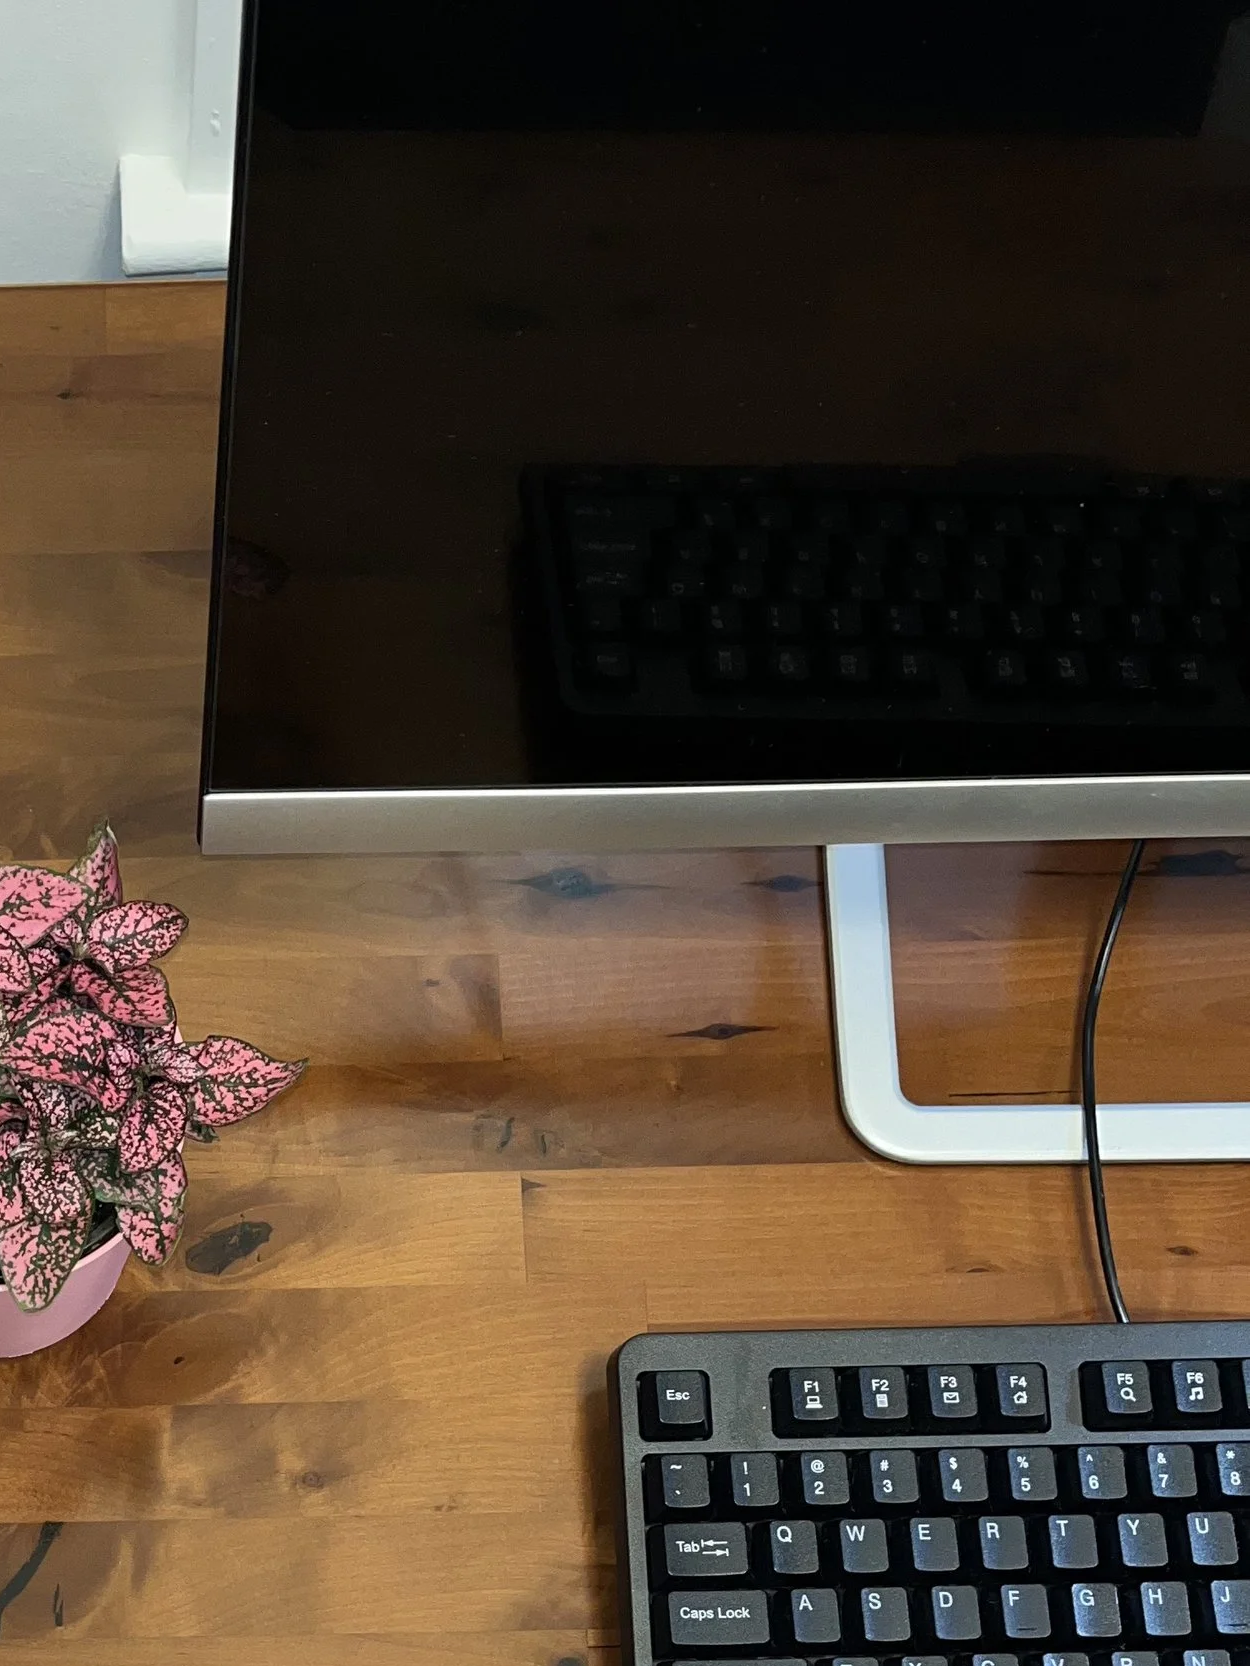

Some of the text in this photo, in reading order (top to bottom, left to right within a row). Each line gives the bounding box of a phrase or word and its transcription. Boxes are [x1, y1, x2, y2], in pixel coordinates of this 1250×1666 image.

[871, 1378, 890, 1392] F2
[939, 1375, 958, 1388] F3
[1009, 1375, 1028, 1388] F4
[1116, 1372, 1134, 1386] F5
[1186, 1371, 1205, 1384] F6
[803, 1380, 820, 1393] F1
[666, 1389, 691, 1401] Esc
[879, 1459, 889, 1472] #
[948, 1456, 958, 1470] $
[1016, 1455, 1029, 1469] %
[1156, 1452, 1167, 1465] &
[743, 1461, 749, 1475] !
[810, 1459, 825, 1474] @
[882, 1479, 893, 1493] 3
[951, 1478, 963, 1493] 4
[1020, 1477, 1031, 1492] 5
[1088, 1474, 1100, 1490] 6
[1158, 1473, 1169, 1488] 7
[1230, 1471, 1241, 1486] 8
[743, 1482, 751, 1497] 1
[813, 1480, 825, 1495] 2
[845, 1525, 866, 1542] W
[917, 1523, 932, 1541] E
[985, 1522, 1000, 1539] R
[1055, 1519, 1069, 1537] T
[1126, 1519, 1140, 1536] Y
[1194, 1517, 1209, 1535] U
[776, 1525, 793, 1543] Q
[675, 1540, 700, 1553] Tab
[868, 1592, 882, 1610] S
[938, 1591, 953, 1608] D
[1008, 1590, 1020, 1607] F
[1079, 1588, 1095, 1607] G
[1148, 1588, 1163, 1605] H
[1220, 1586, 1231, 1603] J
[798, 1594, 814, 1611] A
[679, 1606, 751, 1622] Caps Lock
